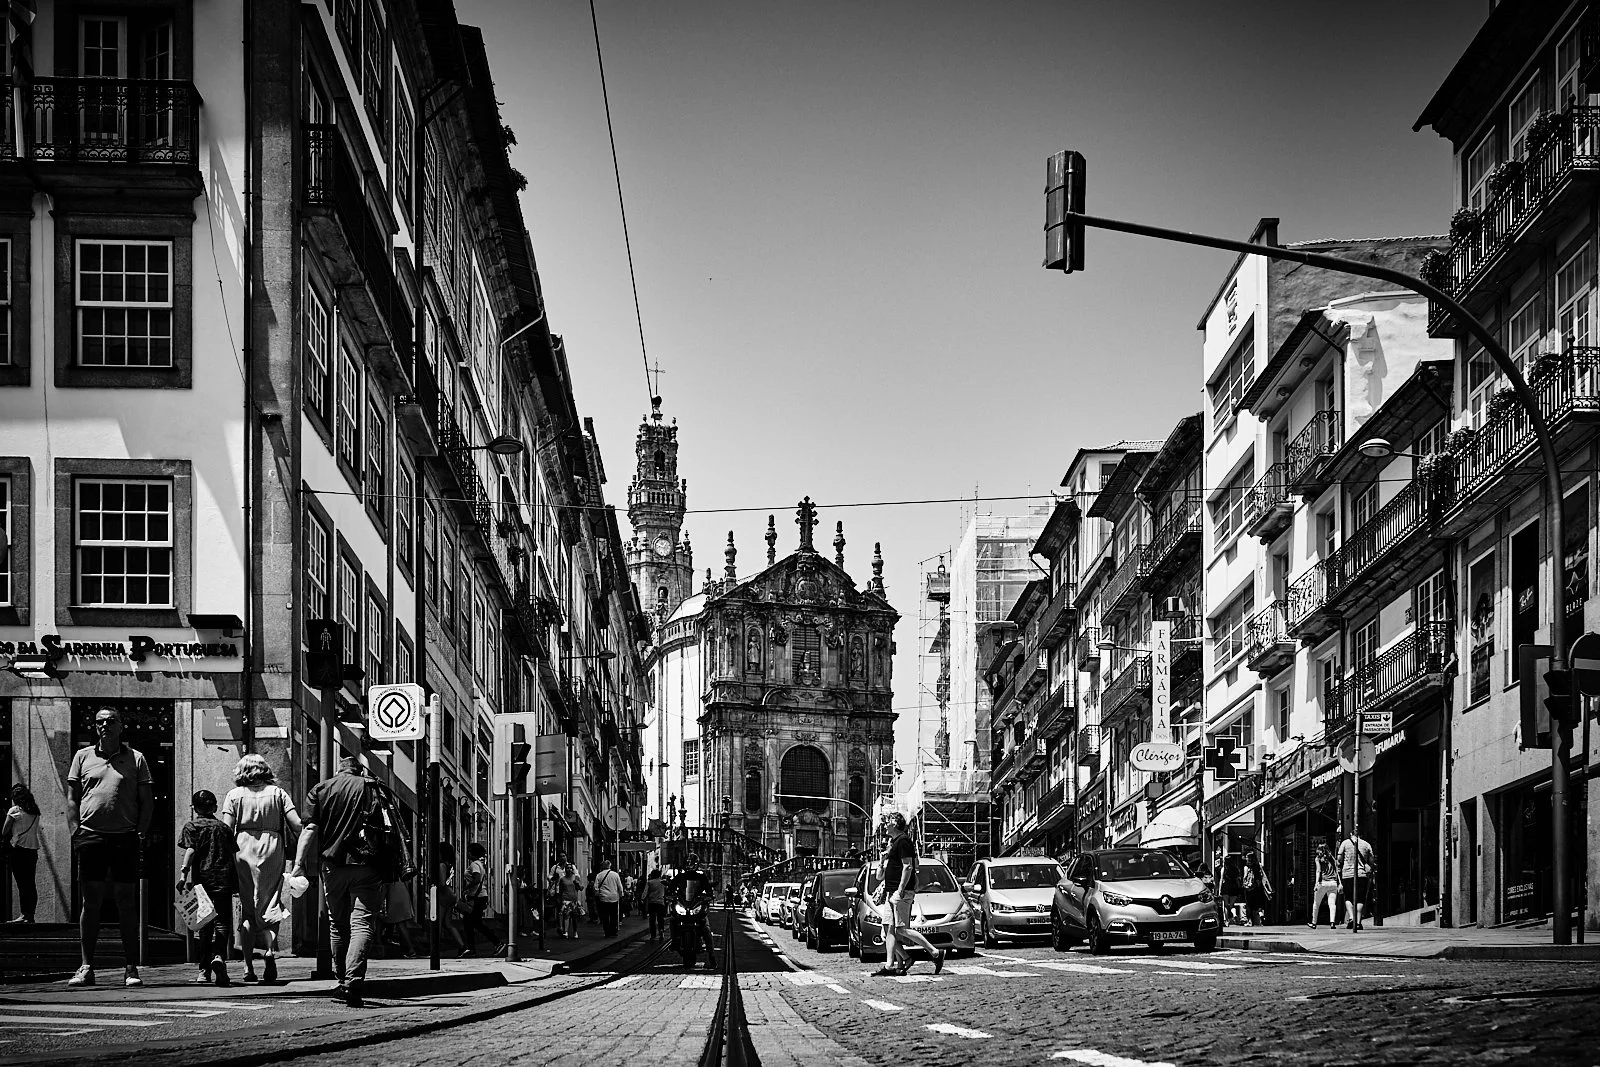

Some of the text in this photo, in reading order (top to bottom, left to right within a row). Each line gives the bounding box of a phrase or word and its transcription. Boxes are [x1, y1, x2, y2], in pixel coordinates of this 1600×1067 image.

[18, 641, 38, 655] DA
[1155, 629, 1168, 729] FARMÁCIA
[1374, 729, 1406, 755] RFUMARIA
[1311, 765, 1345, 790] PERFUMARIA
